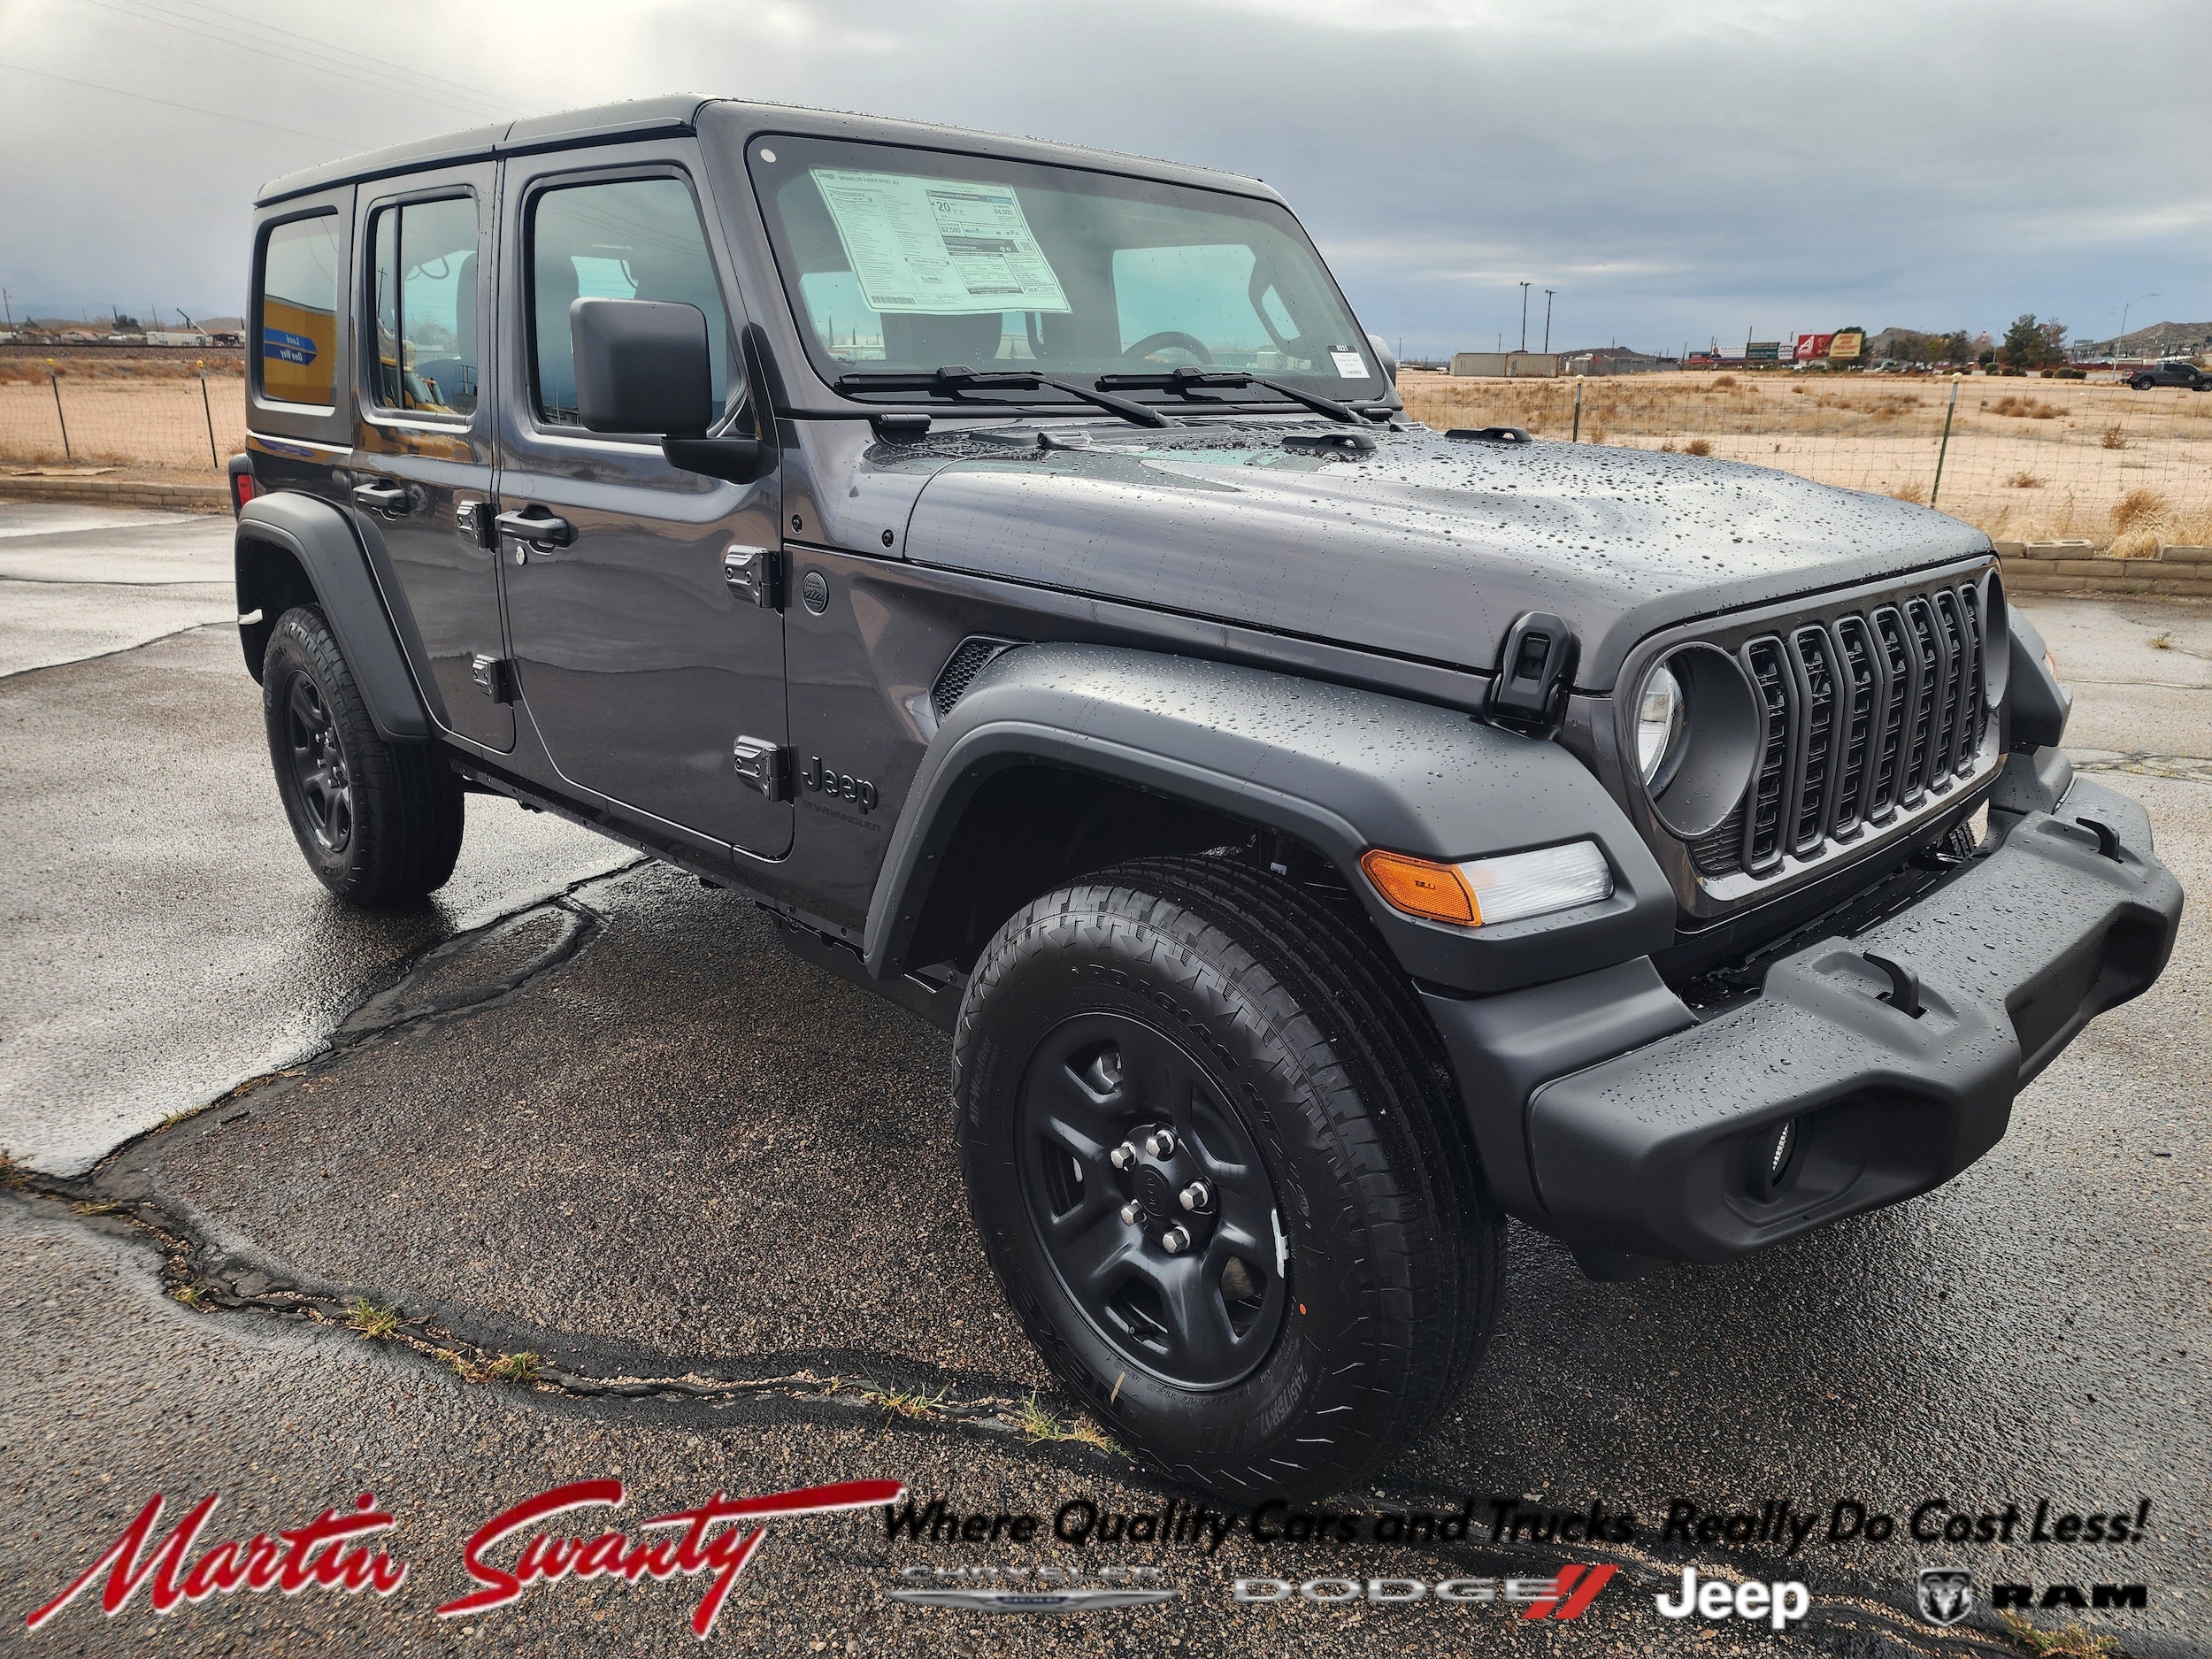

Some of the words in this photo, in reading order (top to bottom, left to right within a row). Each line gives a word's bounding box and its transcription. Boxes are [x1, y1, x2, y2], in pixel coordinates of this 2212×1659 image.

[936, 201, 951, 212] 20
[801, 755, 879, 816] Jeep
[813, 803, 881, 833] WRANGLER
[1087, 963, 1240, 1073] ROADIAN
[969, 1033, 992, 1129] All-Weather
[1260, 1363, 1309, 1436] 245/75R17
